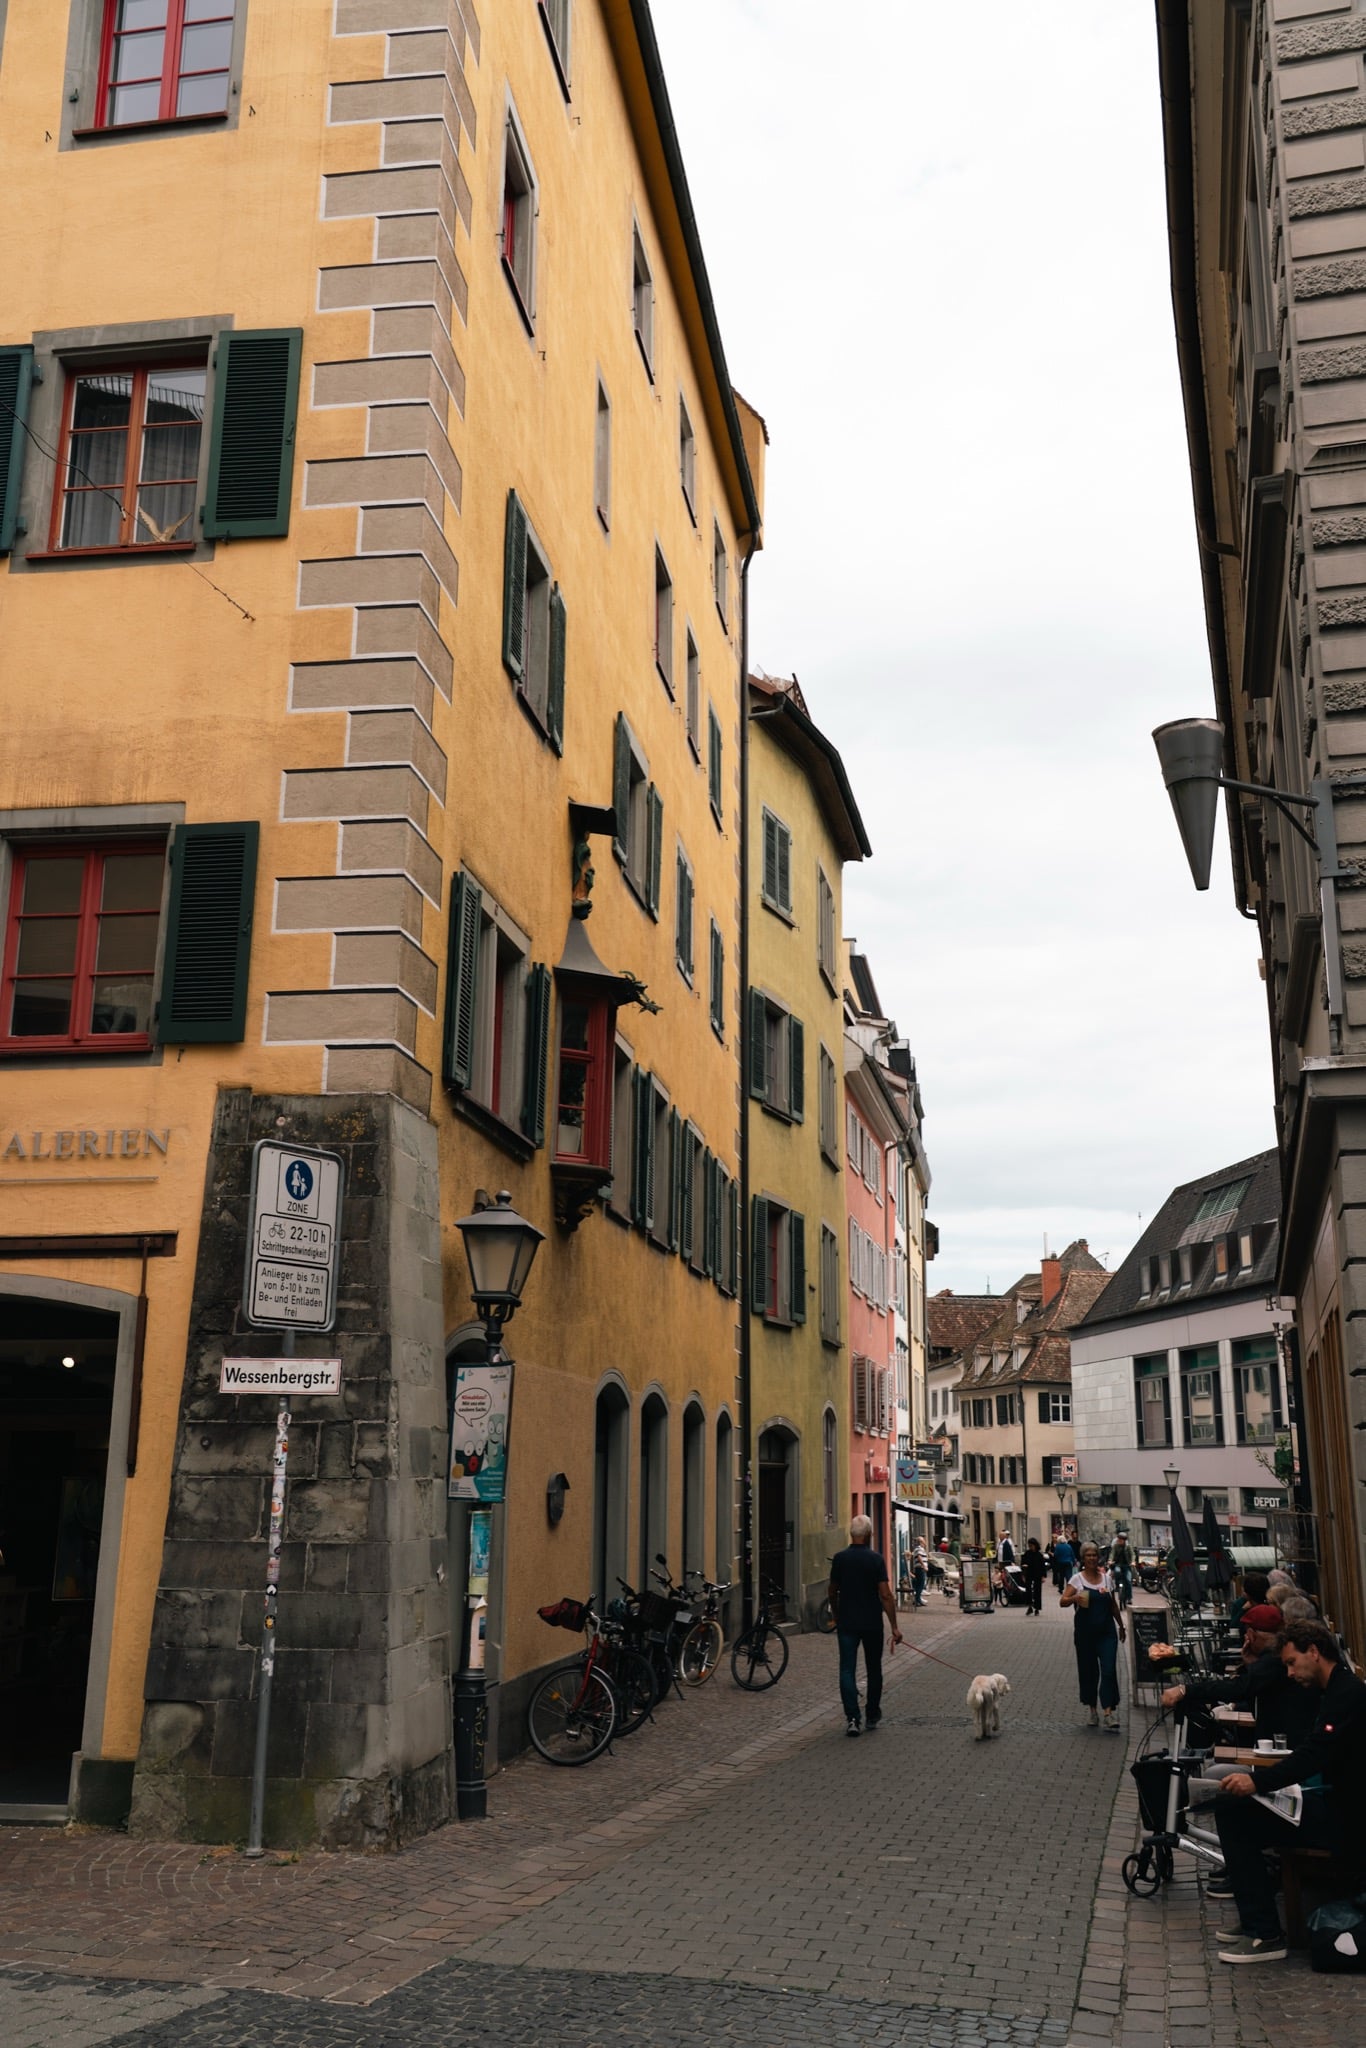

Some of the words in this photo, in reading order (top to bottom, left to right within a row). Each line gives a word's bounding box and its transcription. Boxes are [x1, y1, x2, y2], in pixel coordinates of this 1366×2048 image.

[287, 1201, 309, 1214] ZONE
[290, 1226, 319, 1243] 22-10
[320, 1229, 326, 1244] h
[261, 1240, 327, 1260] Schrittgeschwindigkeit
[261, 1267, 294, 1282] Anlieger
[296, 1270, 308, 1282] bis
[263, 1282, 278, 1291] von
[280, 1281, 297, 1294] 6-10
[298, 1284, 303, 1294] h
[304, 1286, 321, 1296] zum
[258, 1291, 273, 1302] Be-
[274, 1293, 289, 1305] und
[291, 1295, 323, 1308] Entladen
[284, 1306, 298, 1318] frei
[225, 1367, 335, 1388] Wessenbergstr.
[900, 1482, 934, 1497] NAILS
[1253, 1496, 1281, 1508] DEPOT
